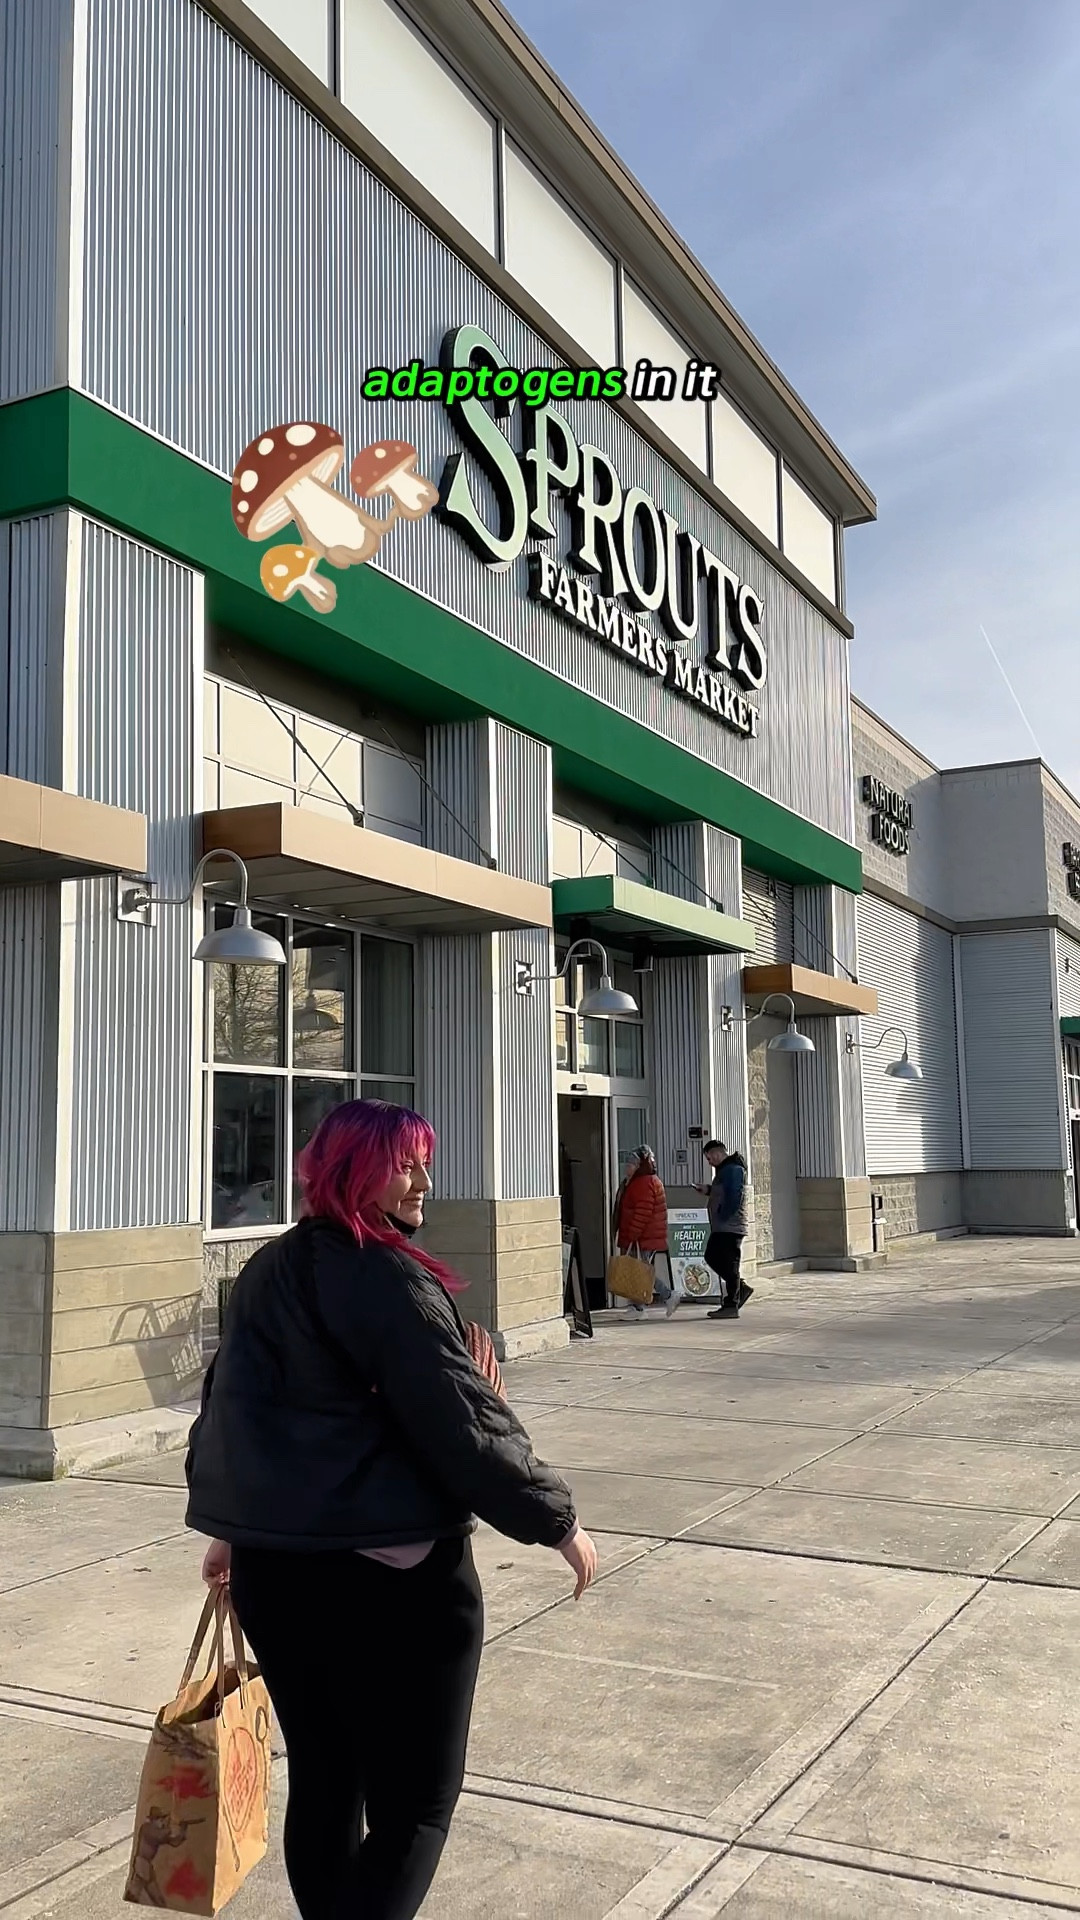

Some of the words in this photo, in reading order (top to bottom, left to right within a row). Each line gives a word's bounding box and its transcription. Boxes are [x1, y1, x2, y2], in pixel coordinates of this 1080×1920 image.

[445, 323, 769, 690] SPROUTS
[539, 551, 668, 677] FARMERS
[673, 649, 760, 739] MARKET
[869, 774, 915, 829] NATURAL
[879, 813, 910, 855] FOODS
[674, 1230, 706, 1241] HEALTHY
[680, 1240, 703, 1251] START
